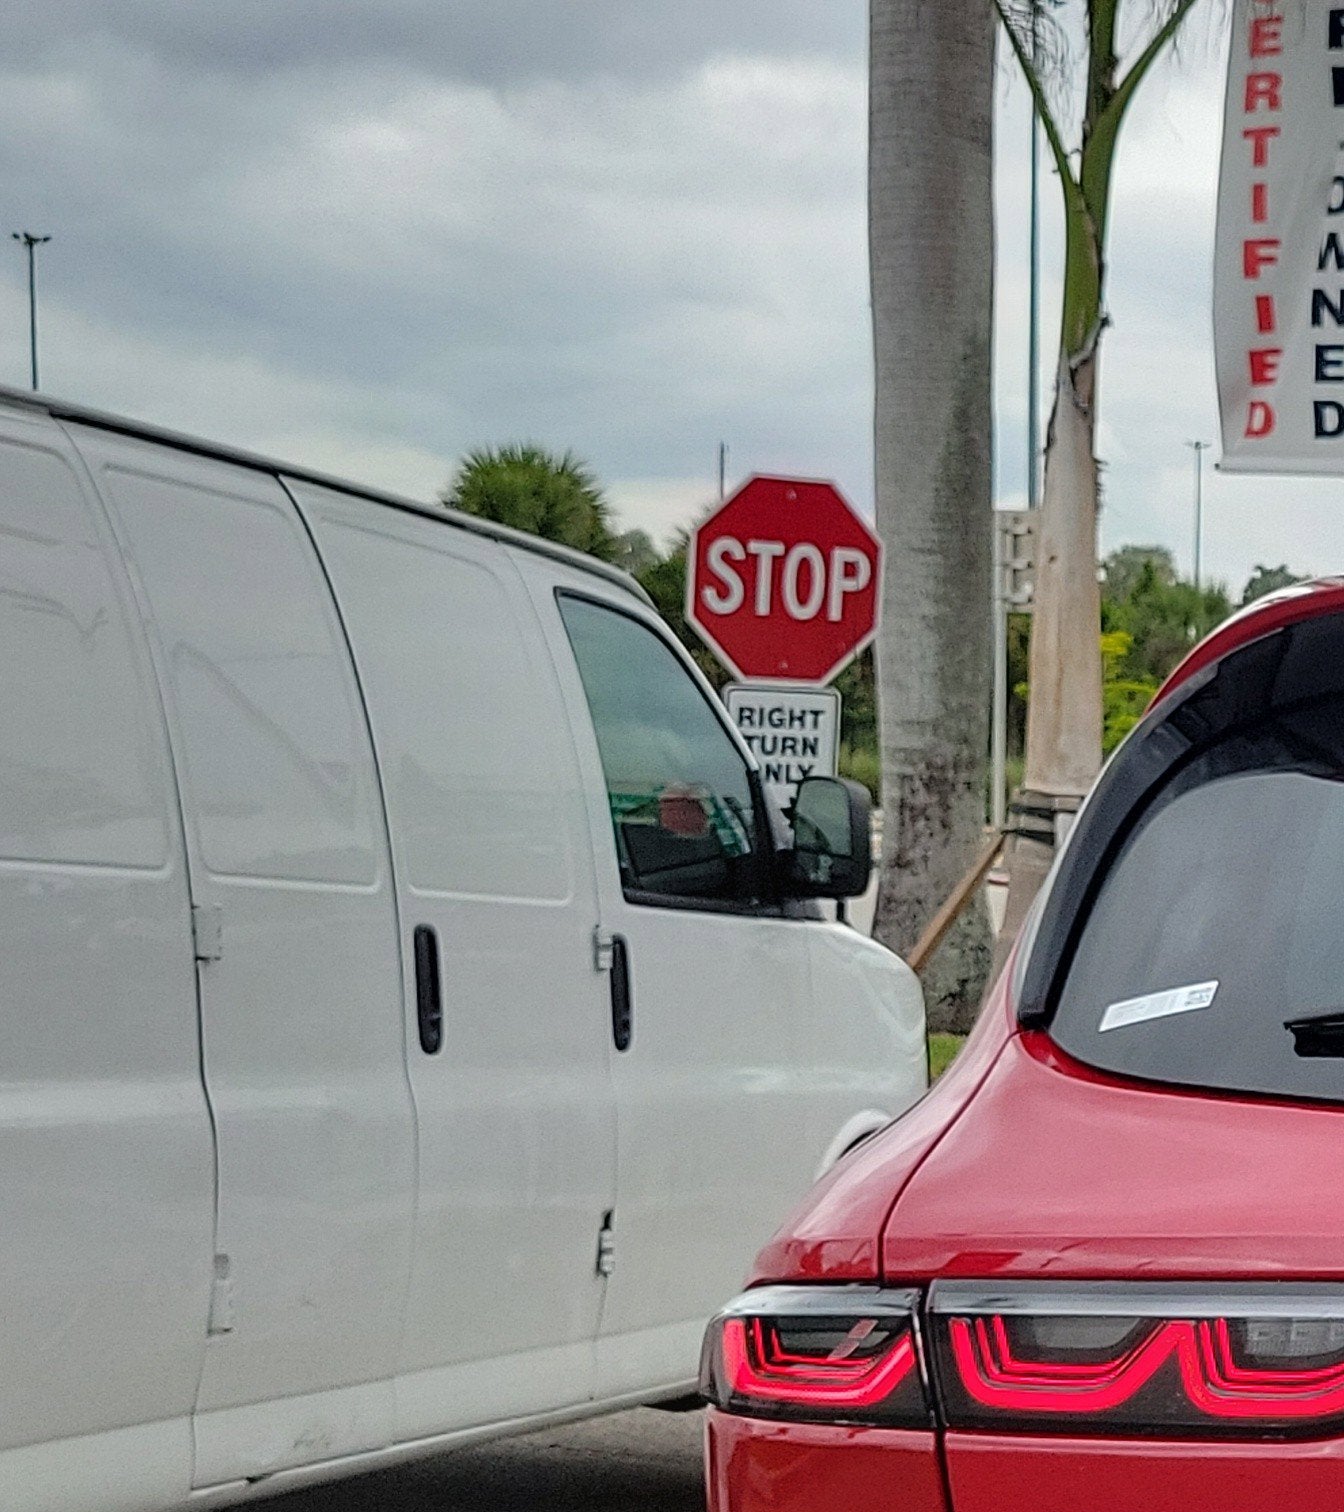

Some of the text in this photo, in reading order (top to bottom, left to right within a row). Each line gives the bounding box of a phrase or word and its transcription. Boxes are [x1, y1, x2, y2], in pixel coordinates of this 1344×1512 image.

[1242, 0, 1284, 438] ERTIFIED
[701, 534, 872, 622] STOP
[738, 707, 825, 730] RIGHT
[742, 735, 819, 756] TURN
[756, 764, 815, 784] NLY
